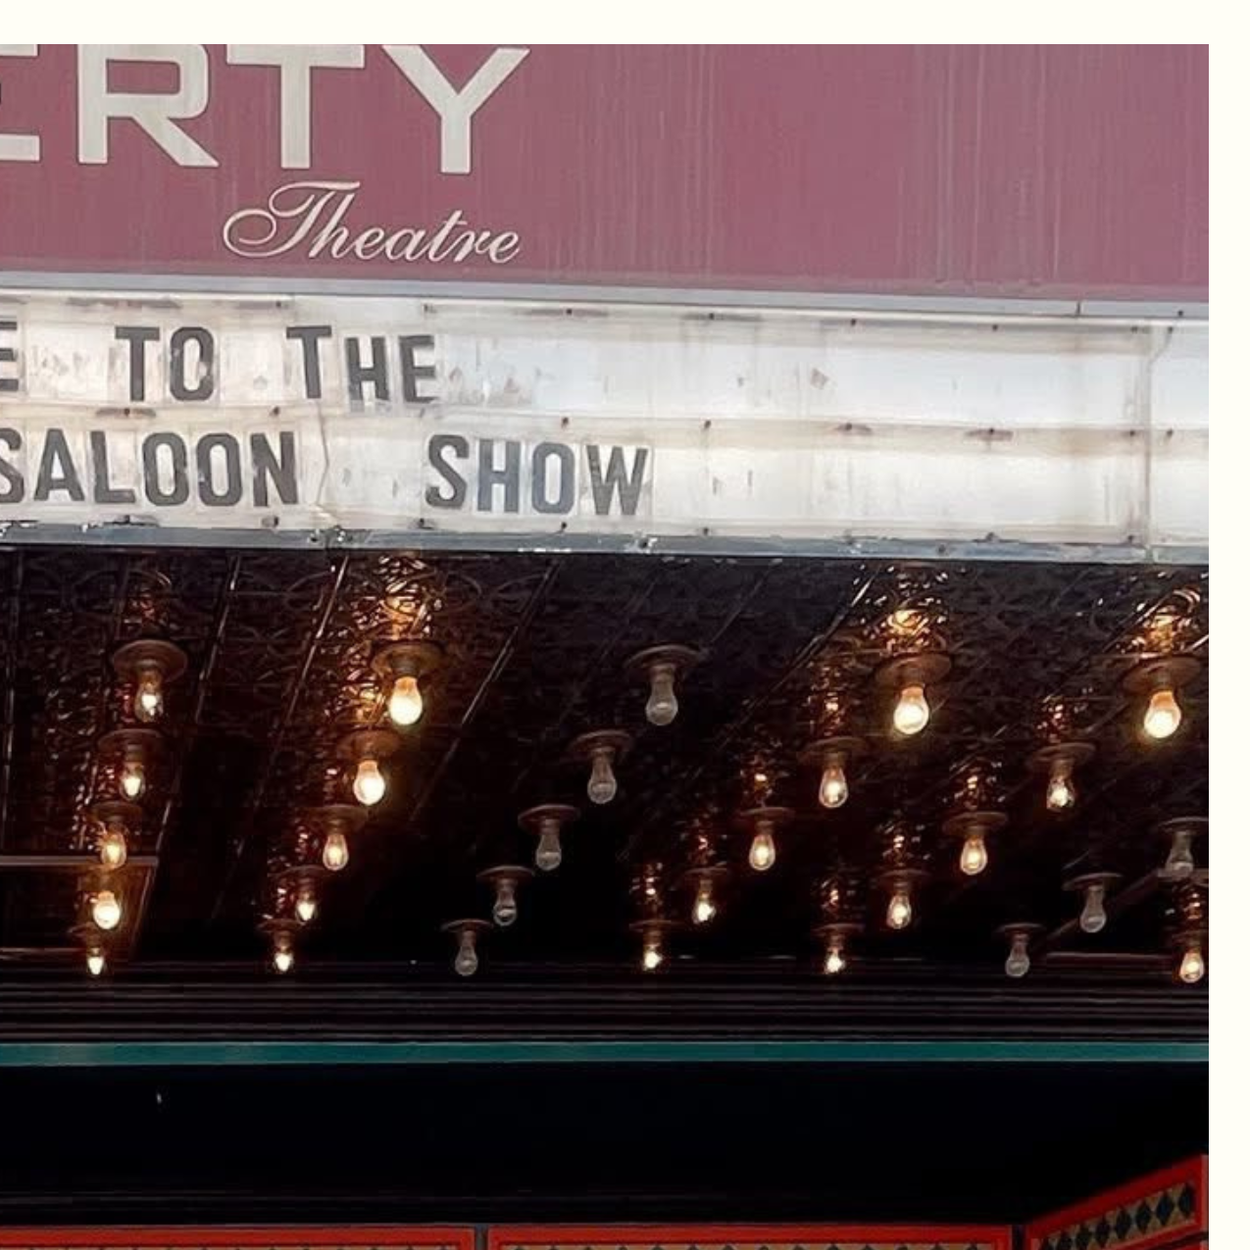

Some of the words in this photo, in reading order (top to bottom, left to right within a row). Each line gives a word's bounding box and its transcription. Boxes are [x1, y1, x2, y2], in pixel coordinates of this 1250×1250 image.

[223, 181, 520, 263] Theatre
[115, 326, 214, 402] TO
[286, 325, 437, 404] THE
[425, 434, 649, 517] SHOW
